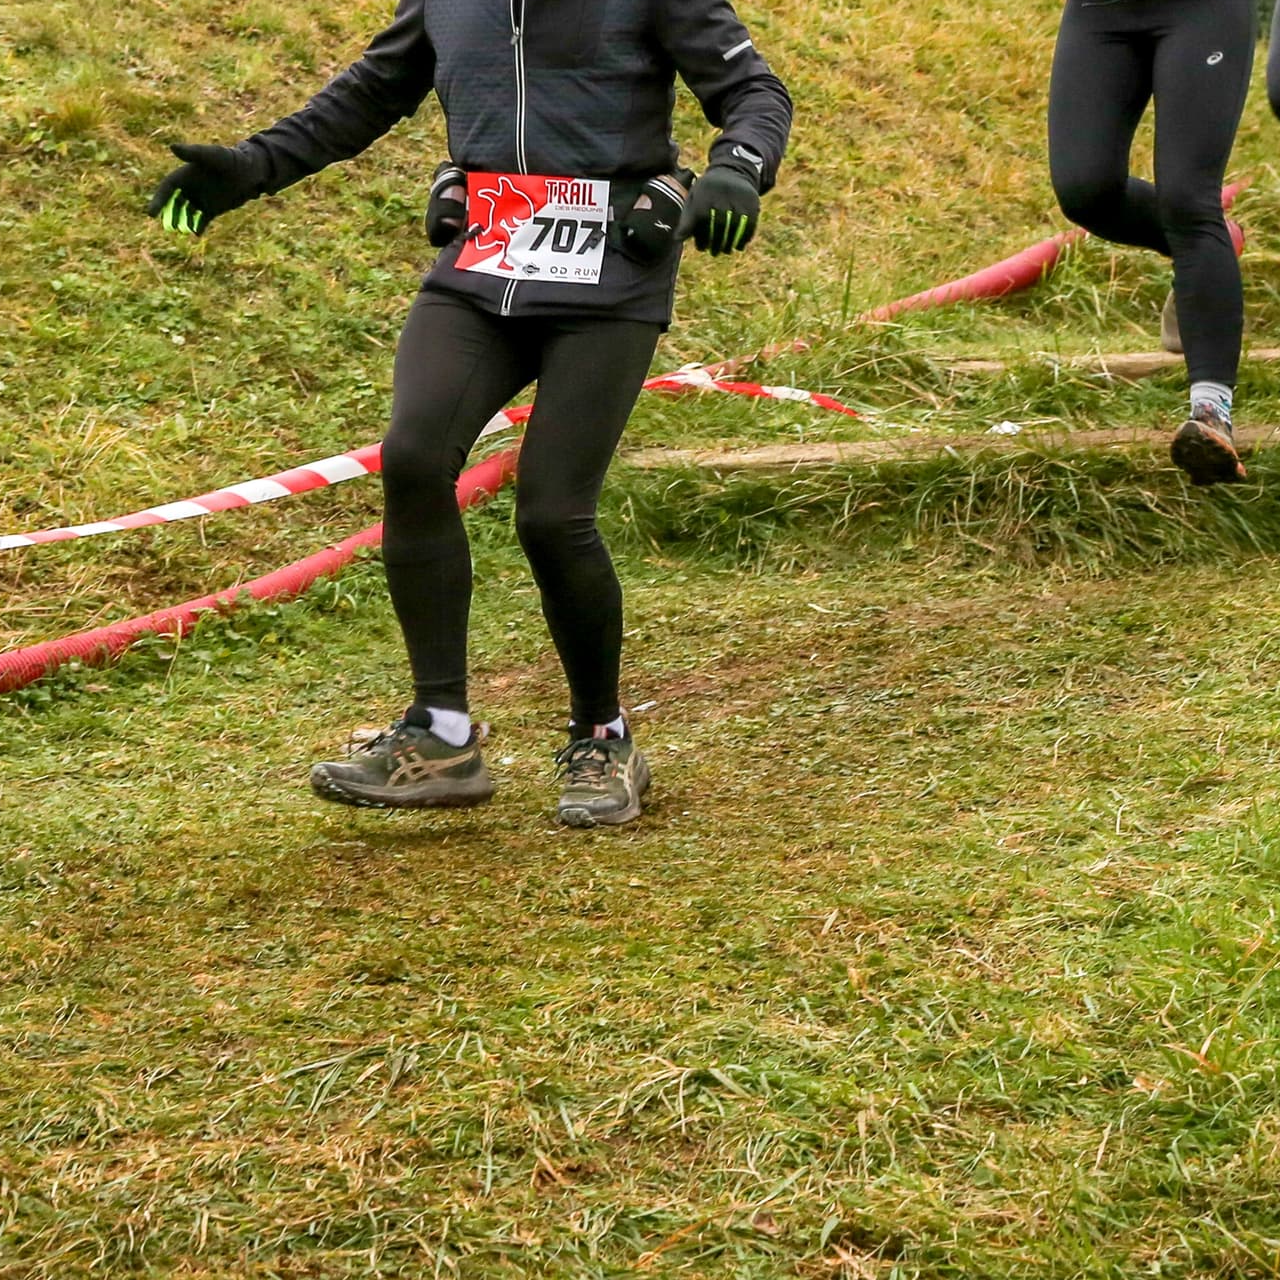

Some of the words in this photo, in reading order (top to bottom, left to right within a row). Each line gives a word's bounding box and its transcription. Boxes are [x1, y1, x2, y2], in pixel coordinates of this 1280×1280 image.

[545, 179, 597, 206] TRAIL
[529, 217, 603, 255] 707
[550, 265, 568, 275] OD
[574, 267, 598, 277] RUN
